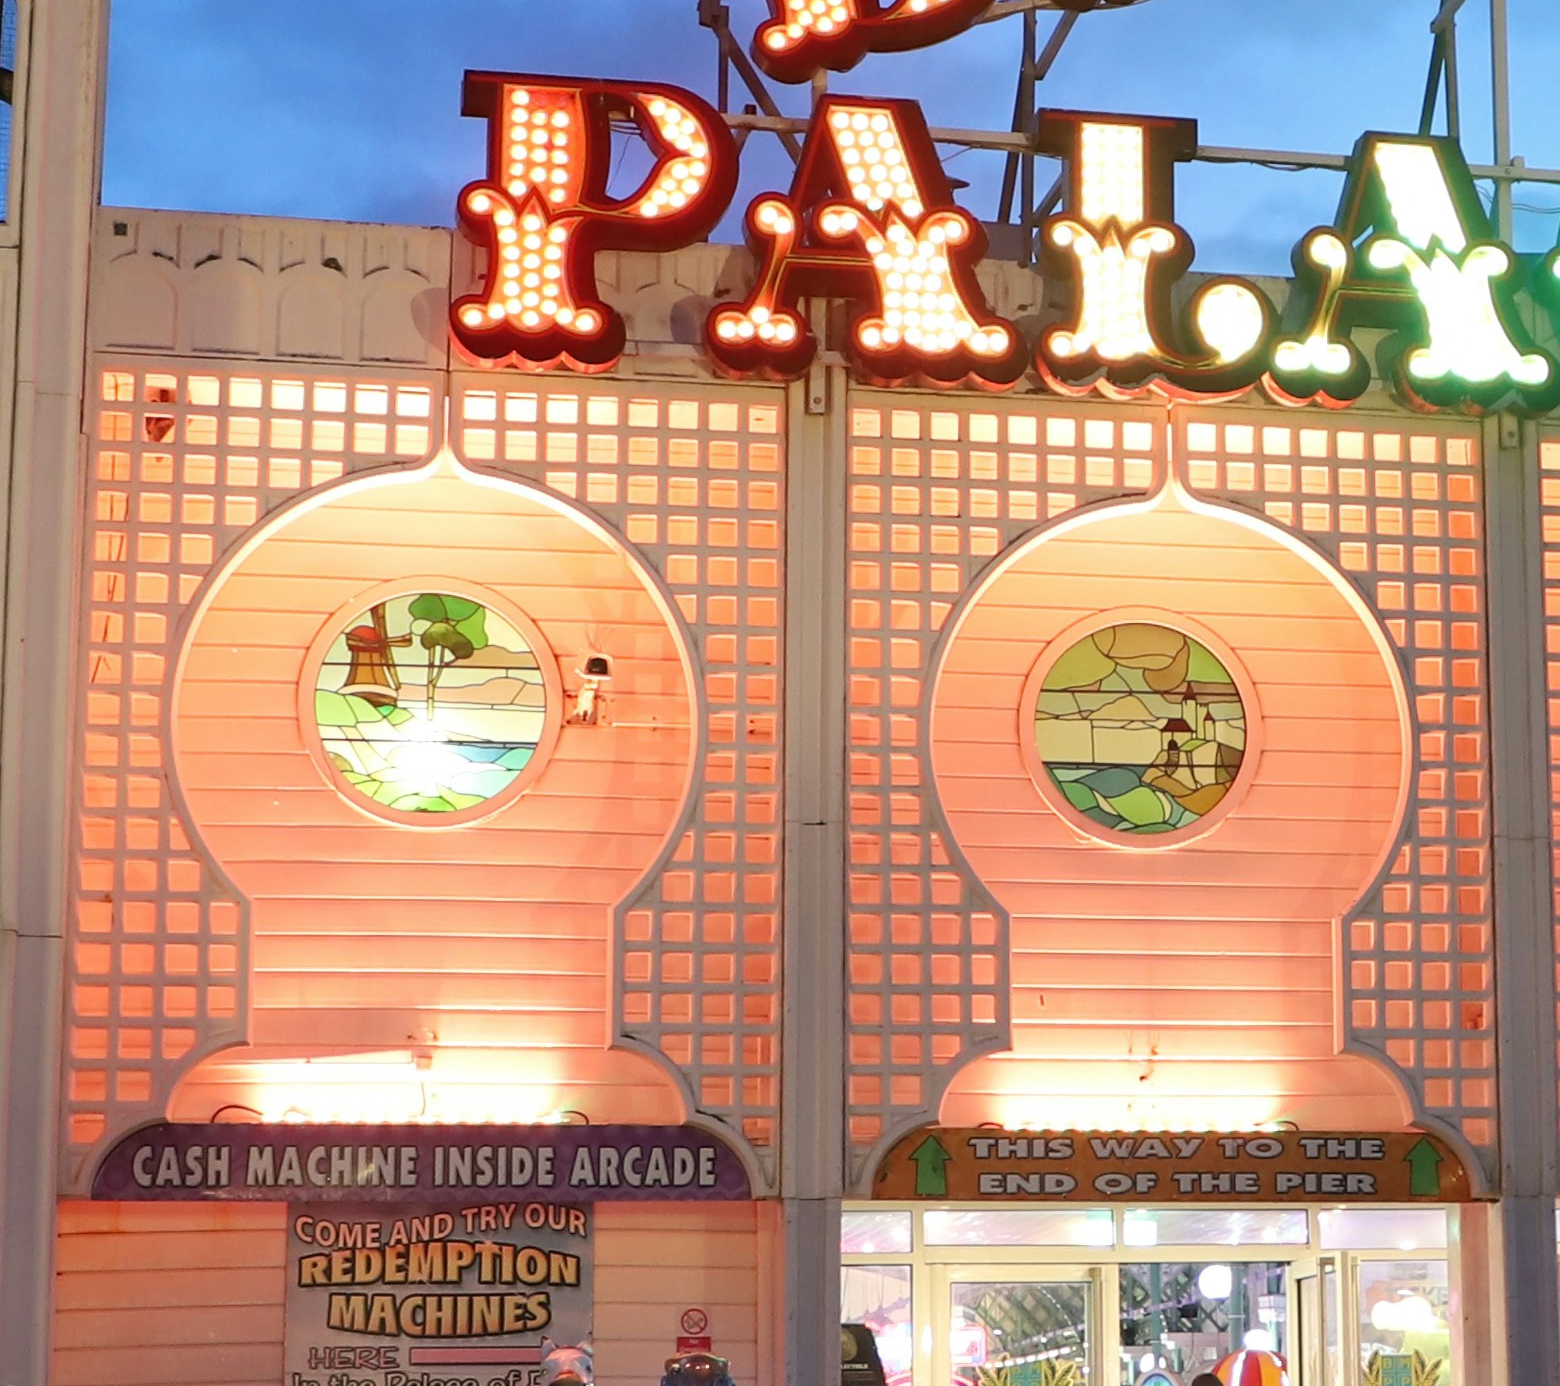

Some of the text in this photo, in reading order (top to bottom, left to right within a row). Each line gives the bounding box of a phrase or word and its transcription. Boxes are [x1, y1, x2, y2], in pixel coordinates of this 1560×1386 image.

[132, 1145, 718, 1188] CASH MACHINE INSIDE ARCADE
[967, 1137, 1385, 1161] THIS WAY TO THE
[978, 1172, 1377, 1196] END OF THE PIER
[295, 1202, 586, 1249] COME AND TRY OUR
[299, 1239, 580, 1286] REDEMPTION
[327, 1292, 551, 1338] MACHINES
[308, 1346, 400, 1370] HERE
